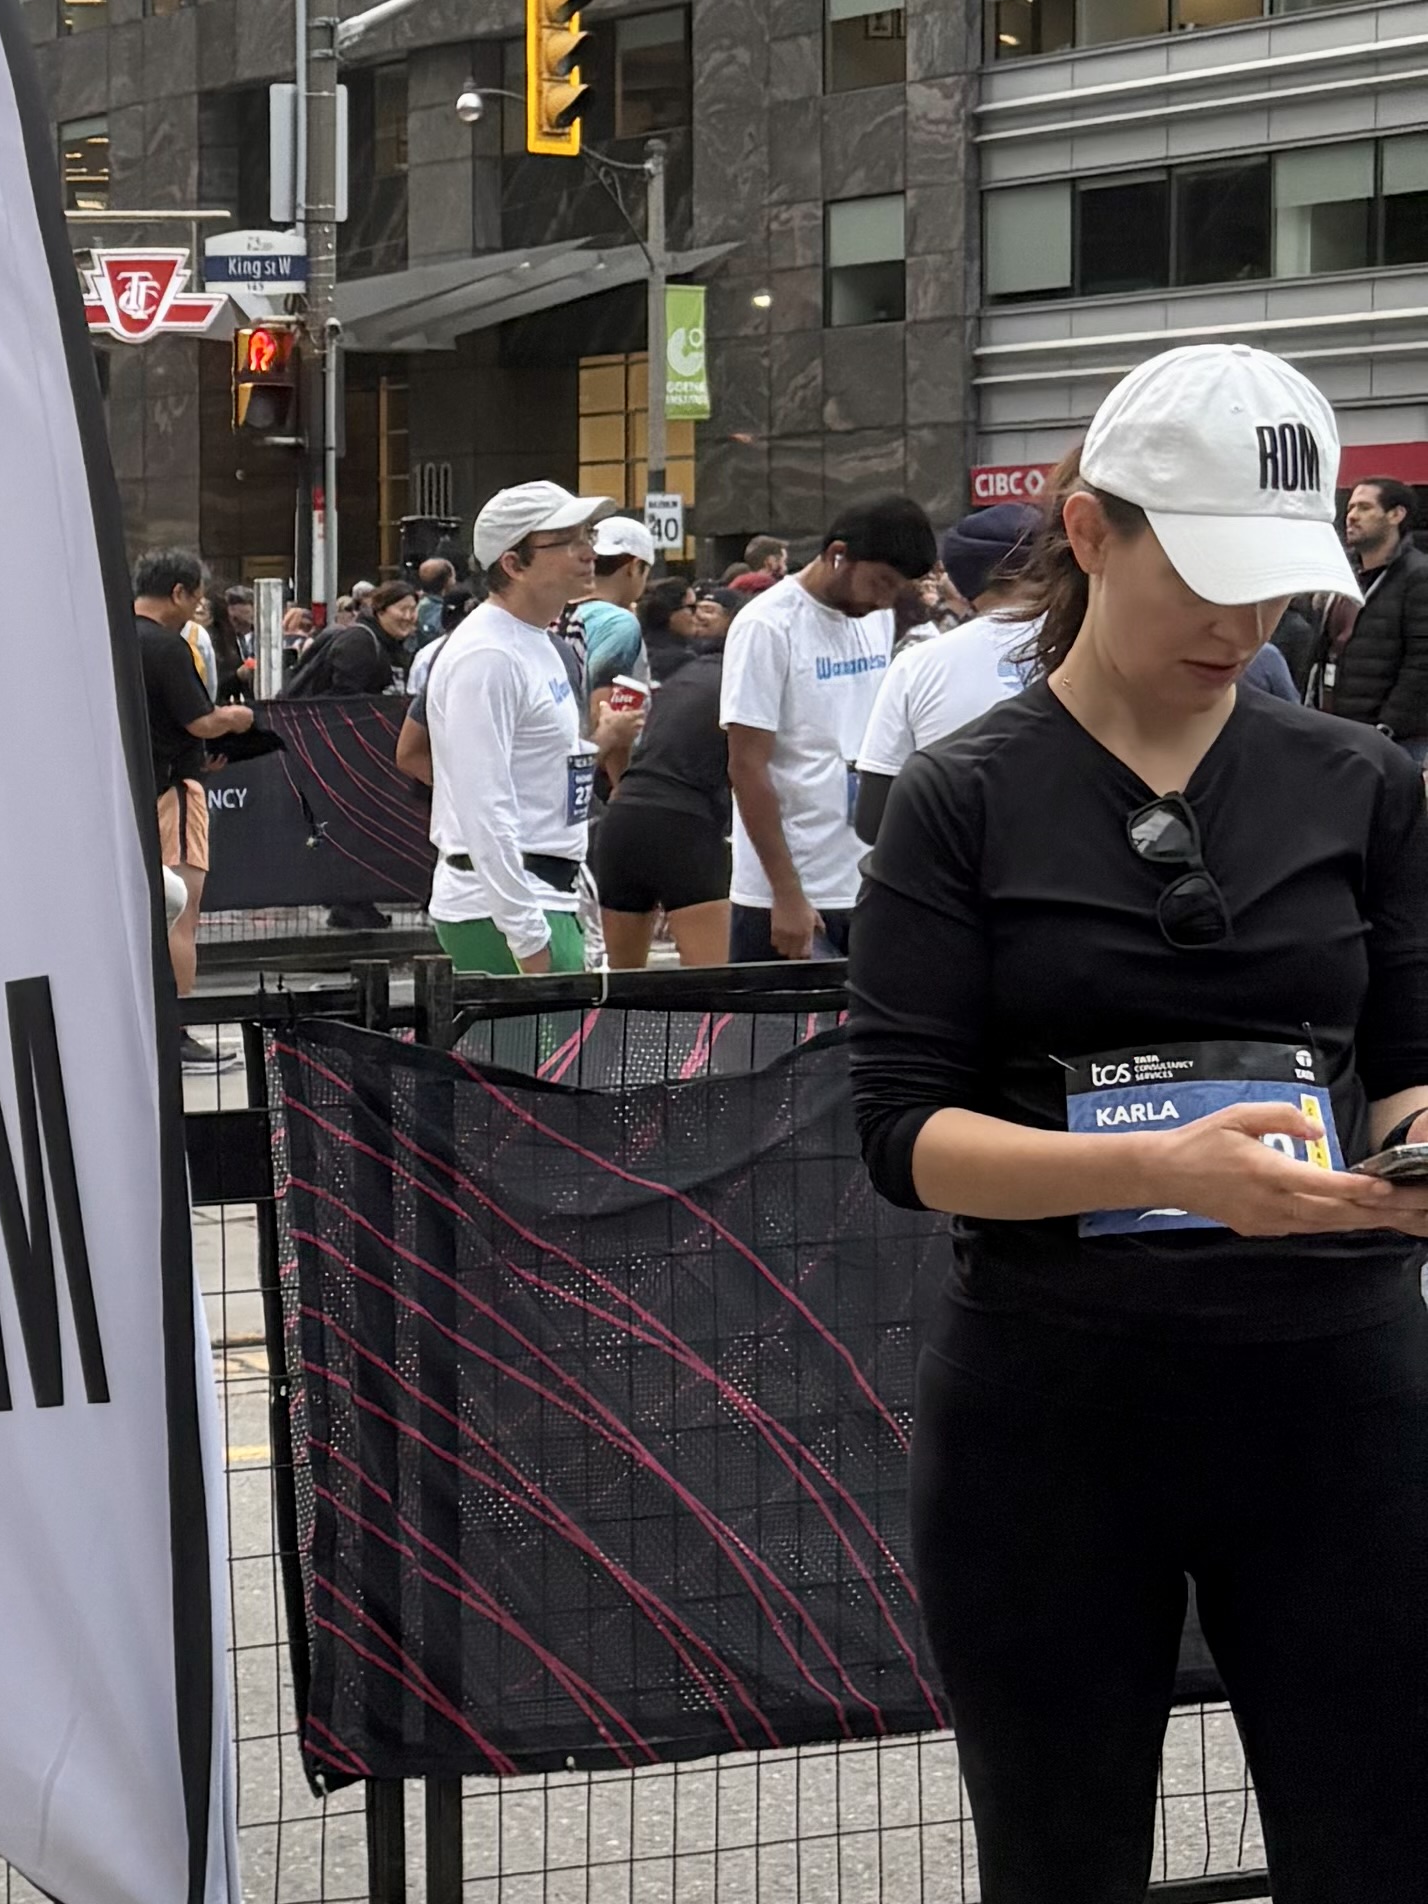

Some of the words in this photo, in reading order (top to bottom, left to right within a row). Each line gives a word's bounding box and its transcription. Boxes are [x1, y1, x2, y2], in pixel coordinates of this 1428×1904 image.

[228, 256, 261, 279] King
[264, 259, 276, 275] St
[278, 256, 292, 276] W
[1256, 423, 1321, 492] ROM
[975, 471, 1023, 498] CIBC
[208, 788, 246, 810] NCY
[1091, 1062, 1132, 1087] tcs
[1135, 1070, 1174, 1081] SERVICES
[1095, 1099, 1180, 1127] KARLA
